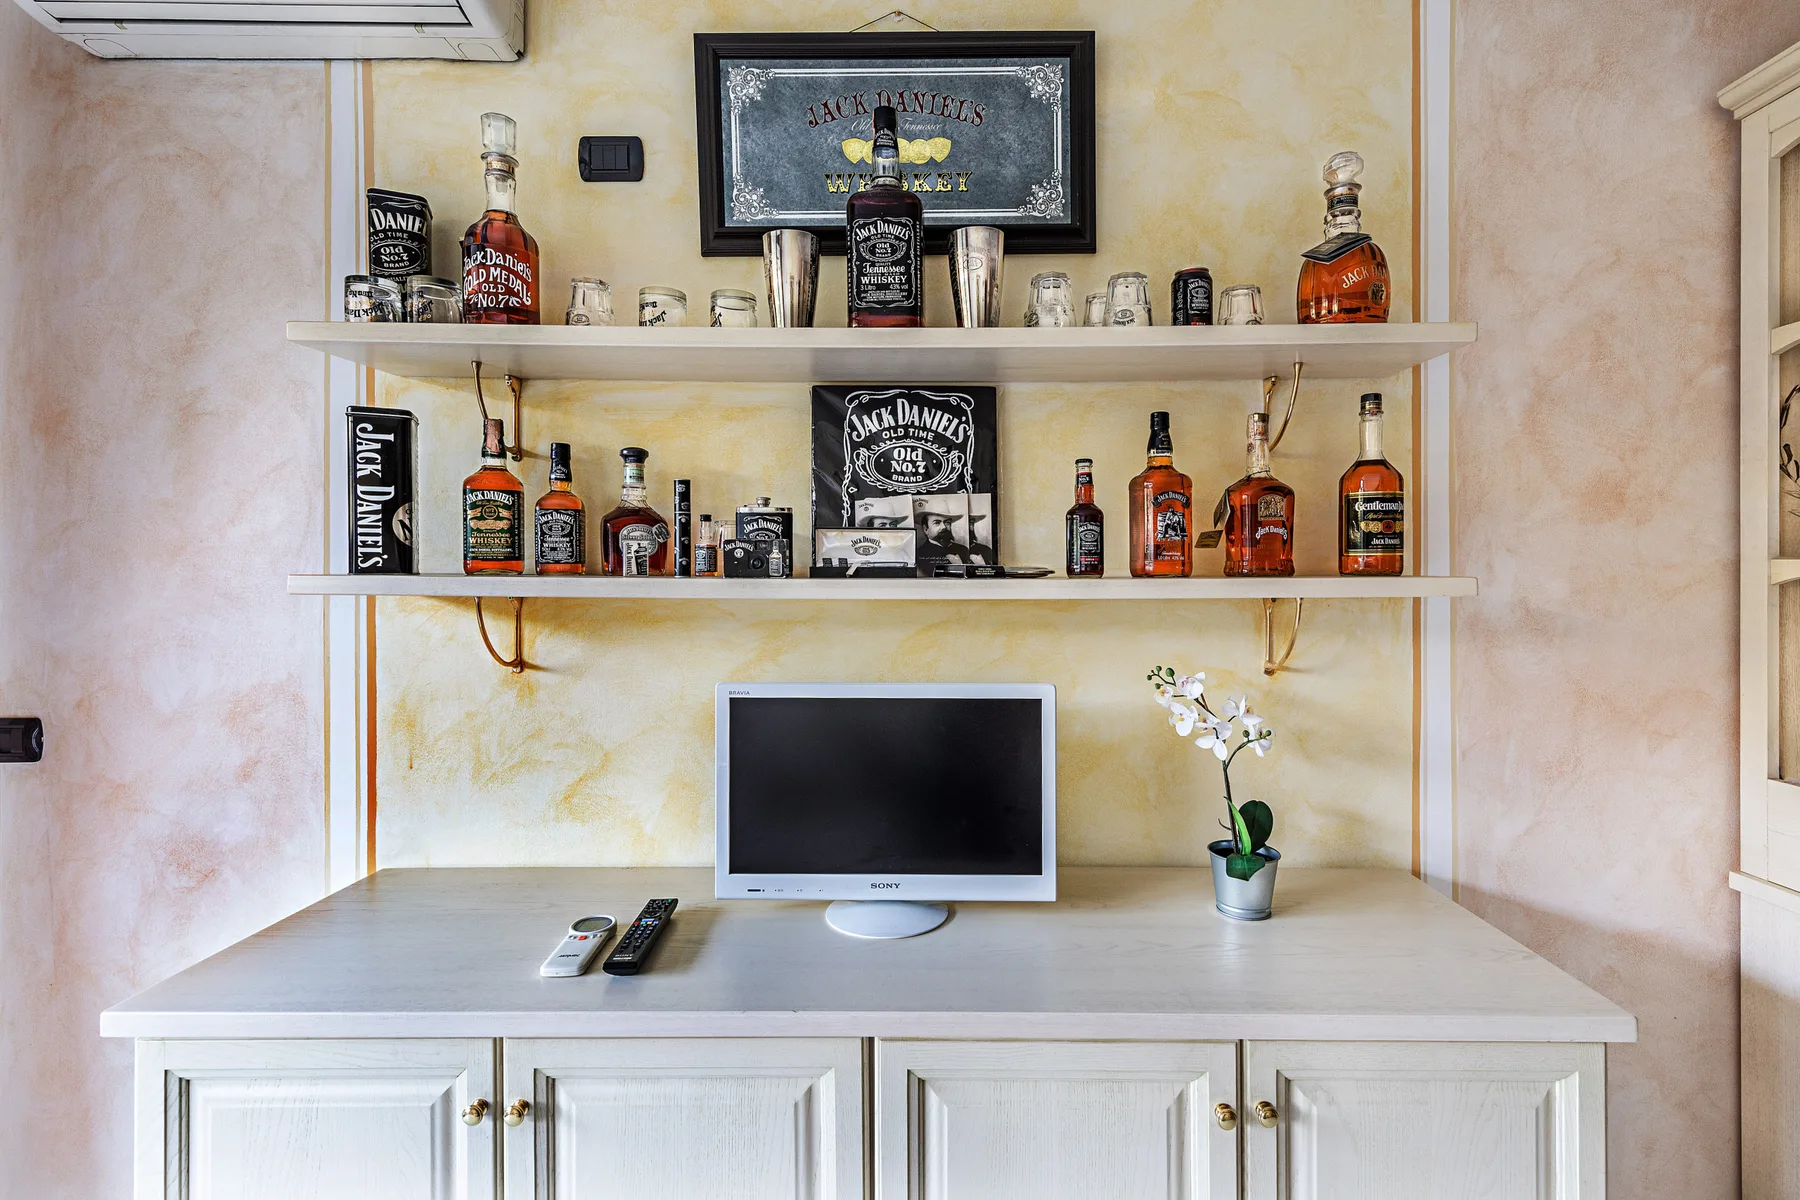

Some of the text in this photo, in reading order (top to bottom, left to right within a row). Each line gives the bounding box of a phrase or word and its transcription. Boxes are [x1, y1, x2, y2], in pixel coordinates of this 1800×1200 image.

[808, 89, 987, 129] JACK DANIEL'S
[898, 117, 943, 131] Tennessee
[824, 171, 973, 193] WHSKEY
[386, 231, 409, 239] TIME
[855, 220, 911, 241] JACK DANIEL'S
[380, 245, 404, 255] Old
[380, 253, 409, 262] No.7
[463, 248, 532, 282] Jack Daniel's
[862, 262, 906, 274] Tennessee
[860, 275, 908, 284] WHISKEY
[1341, 265, 1370, 288] JACK
[463, 266, 532, 305] GOLD MEDAL
[481, 283, 506, 293] OLD
[850, 398, 970, 443] JACK DANIEL'S
[881, 428, 935, 441] OLD TIME
[893, 447, 923, 462] Old
[890, 460, 927, 474] No.7
[892, 474, 923, 483] BRAND
[355, 422, 396, 569] JACK DANIEL'S
[466, 490, 514, 505] JACK DANIEL'S
[1355, 500, 1399, 512] Gentleman
[538, 511, 576, 525] JACK DANIEL'S
[743, 518, 783, 534] JACK DANIEL'S
[724, 540, 755, 552] JACK DANIEL'S
[850, 535, 882, 549] JACK DANIEL'S
[1371, 537, 1385, 545] JACK
[870, 882, 901, 890] SONY
